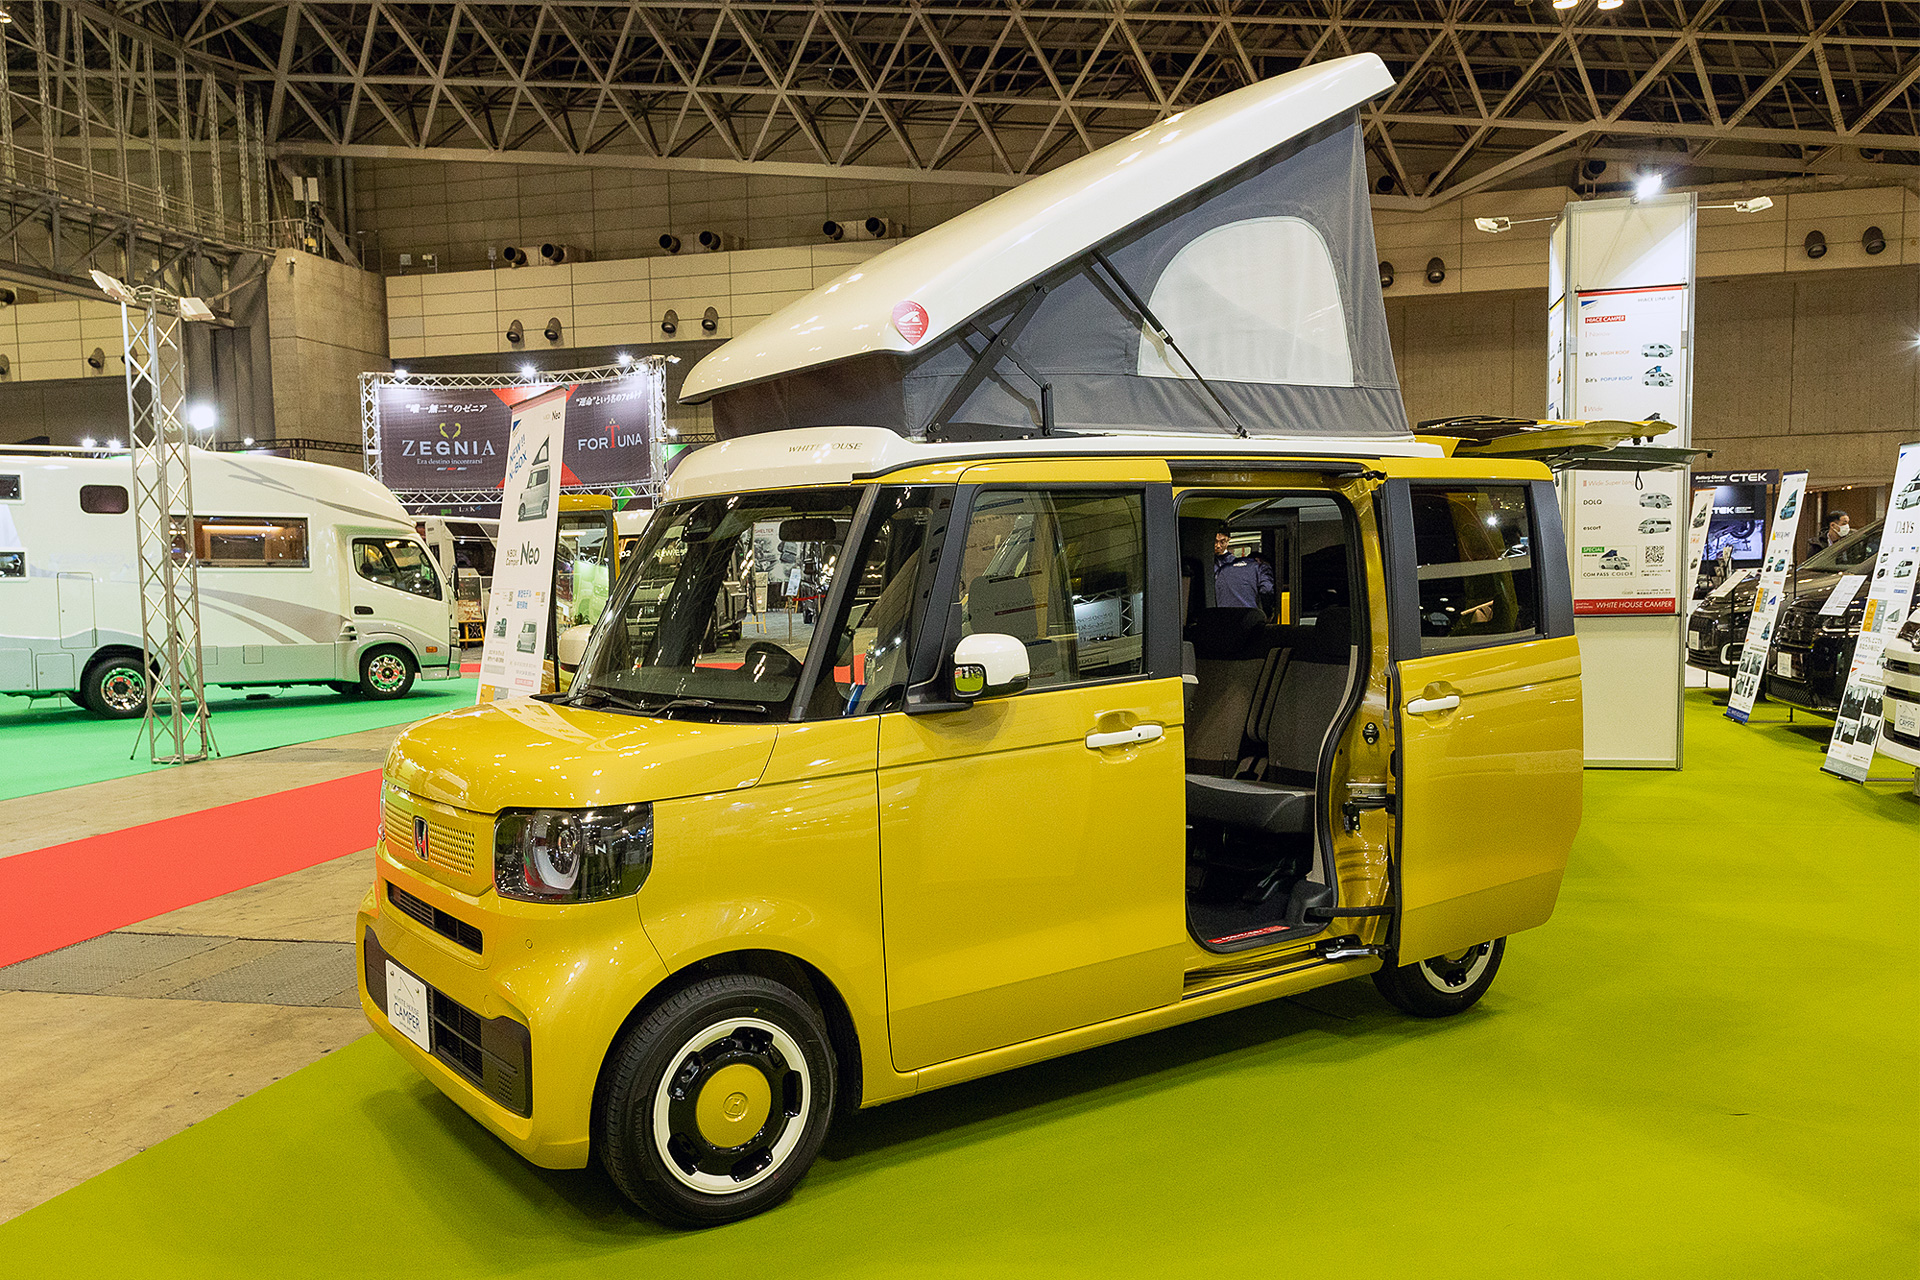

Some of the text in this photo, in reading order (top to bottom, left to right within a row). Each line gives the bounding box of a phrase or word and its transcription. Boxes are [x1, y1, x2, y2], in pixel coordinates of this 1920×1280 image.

[578, 424, 643, 451] FORTUNA
[402, 440, 496, 456] ZEGNIA
[1729, 472, 1767, 482] CTEK
[1711, 506, 1735, 514] TEK
[520, 541, 540, 566] Neo
[394, 1002, 421, 1032] CAMPER
